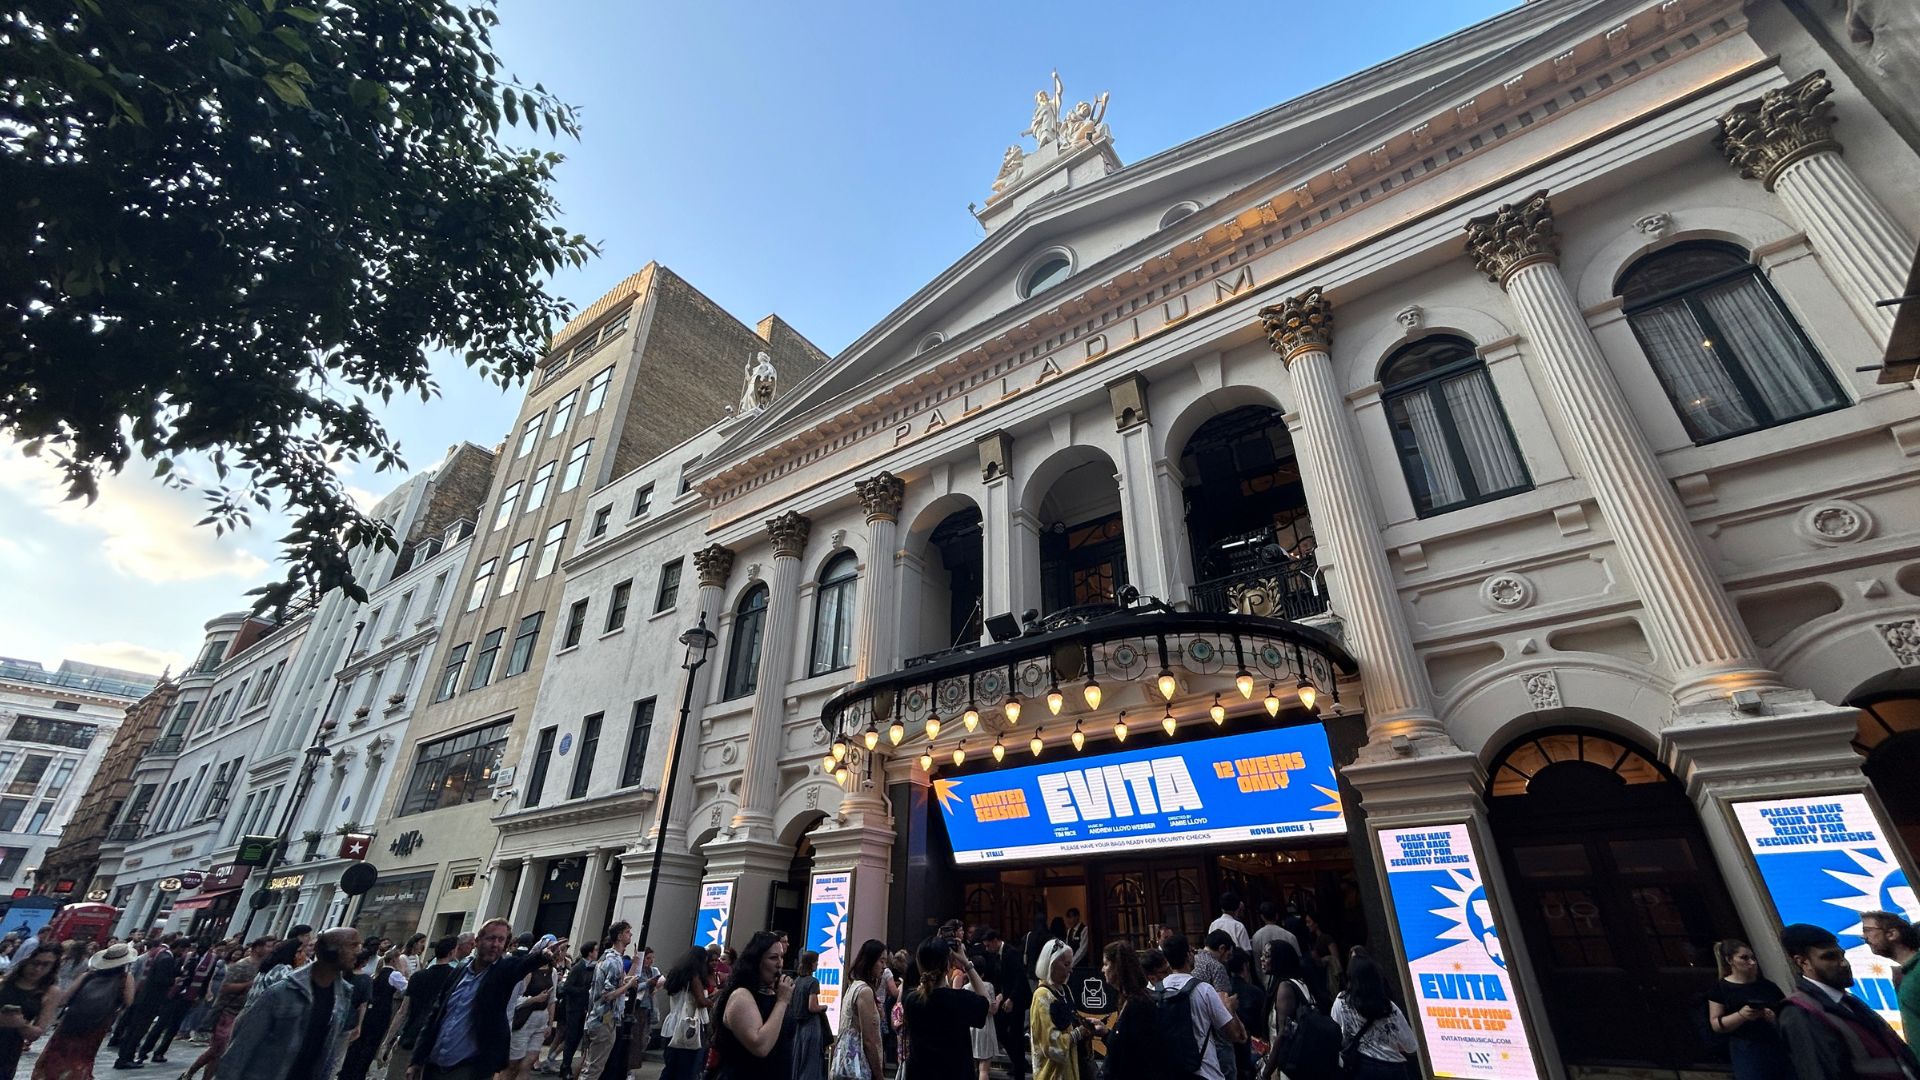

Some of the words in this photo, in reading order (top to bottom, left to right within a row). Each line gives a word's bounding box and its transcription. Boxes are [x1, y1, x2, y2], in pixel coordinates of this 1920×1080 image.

[893, 265, 1254, 447] PALLADIUM
[1213, 761, 1235, 778] 12
[1235, 752, 1306, 776] WEEKS
[1237, 771, 1290, 793] ONLY
[1037, 755, 1203, 824] EVITA
[970, 788, 1026, 808] LIMITED
[974, 803, 1030, 822] SEASON
[1760, 806, 1806, 817] PLEASE
[1806, 803, 1843, 814] HAVE
[1170, 819, 1188, 827] JAMIE
[1768, 816, 1806, 826] YOUR
[1806, 813, 1843, 824] BAGS
[1131, 822, 1156, 831] WEBBER
[1250, 827, 1276, 836] ROYAL
[1276, 824, 1305, 833] CIRCLE
[1773, 825, 1817, 836] READY
[1819, 823, 1847, 833] FOR
[1186, 833, 1211, 841] CHECKS
[1395, 833, 1427, 843] PLEASE
[1427, 832, 1452, 840] HAVE
[1756, 835, 1818, 847] SECURITY
[1820, 831, 1876, 843] CHECKS
[1401, 841, 1426, 849] YOUR
[1426, 840, 1450, 848] BAGS
[1403, 849, 1432, 857] READY
[1433, 848, 1452, 856] FOR
[1390, 857, 1432, 866] SECURITY
[1433, 855, 1470, 864] CHECKS
[815, 969, 839, 985] VITA
[1418, 973, 1508, 1001] EVITA
[1426, 1007, 1457, 1017] NOW
[1458, 1007, 1512, 1020] PLAYING
[1437, 1018, 1472, 1029] UNTIL
[1483, 1019, 1506, 1031] SEP
[1441, 1035, 1512, 1044] EVITATHEMUSICAL.COM
